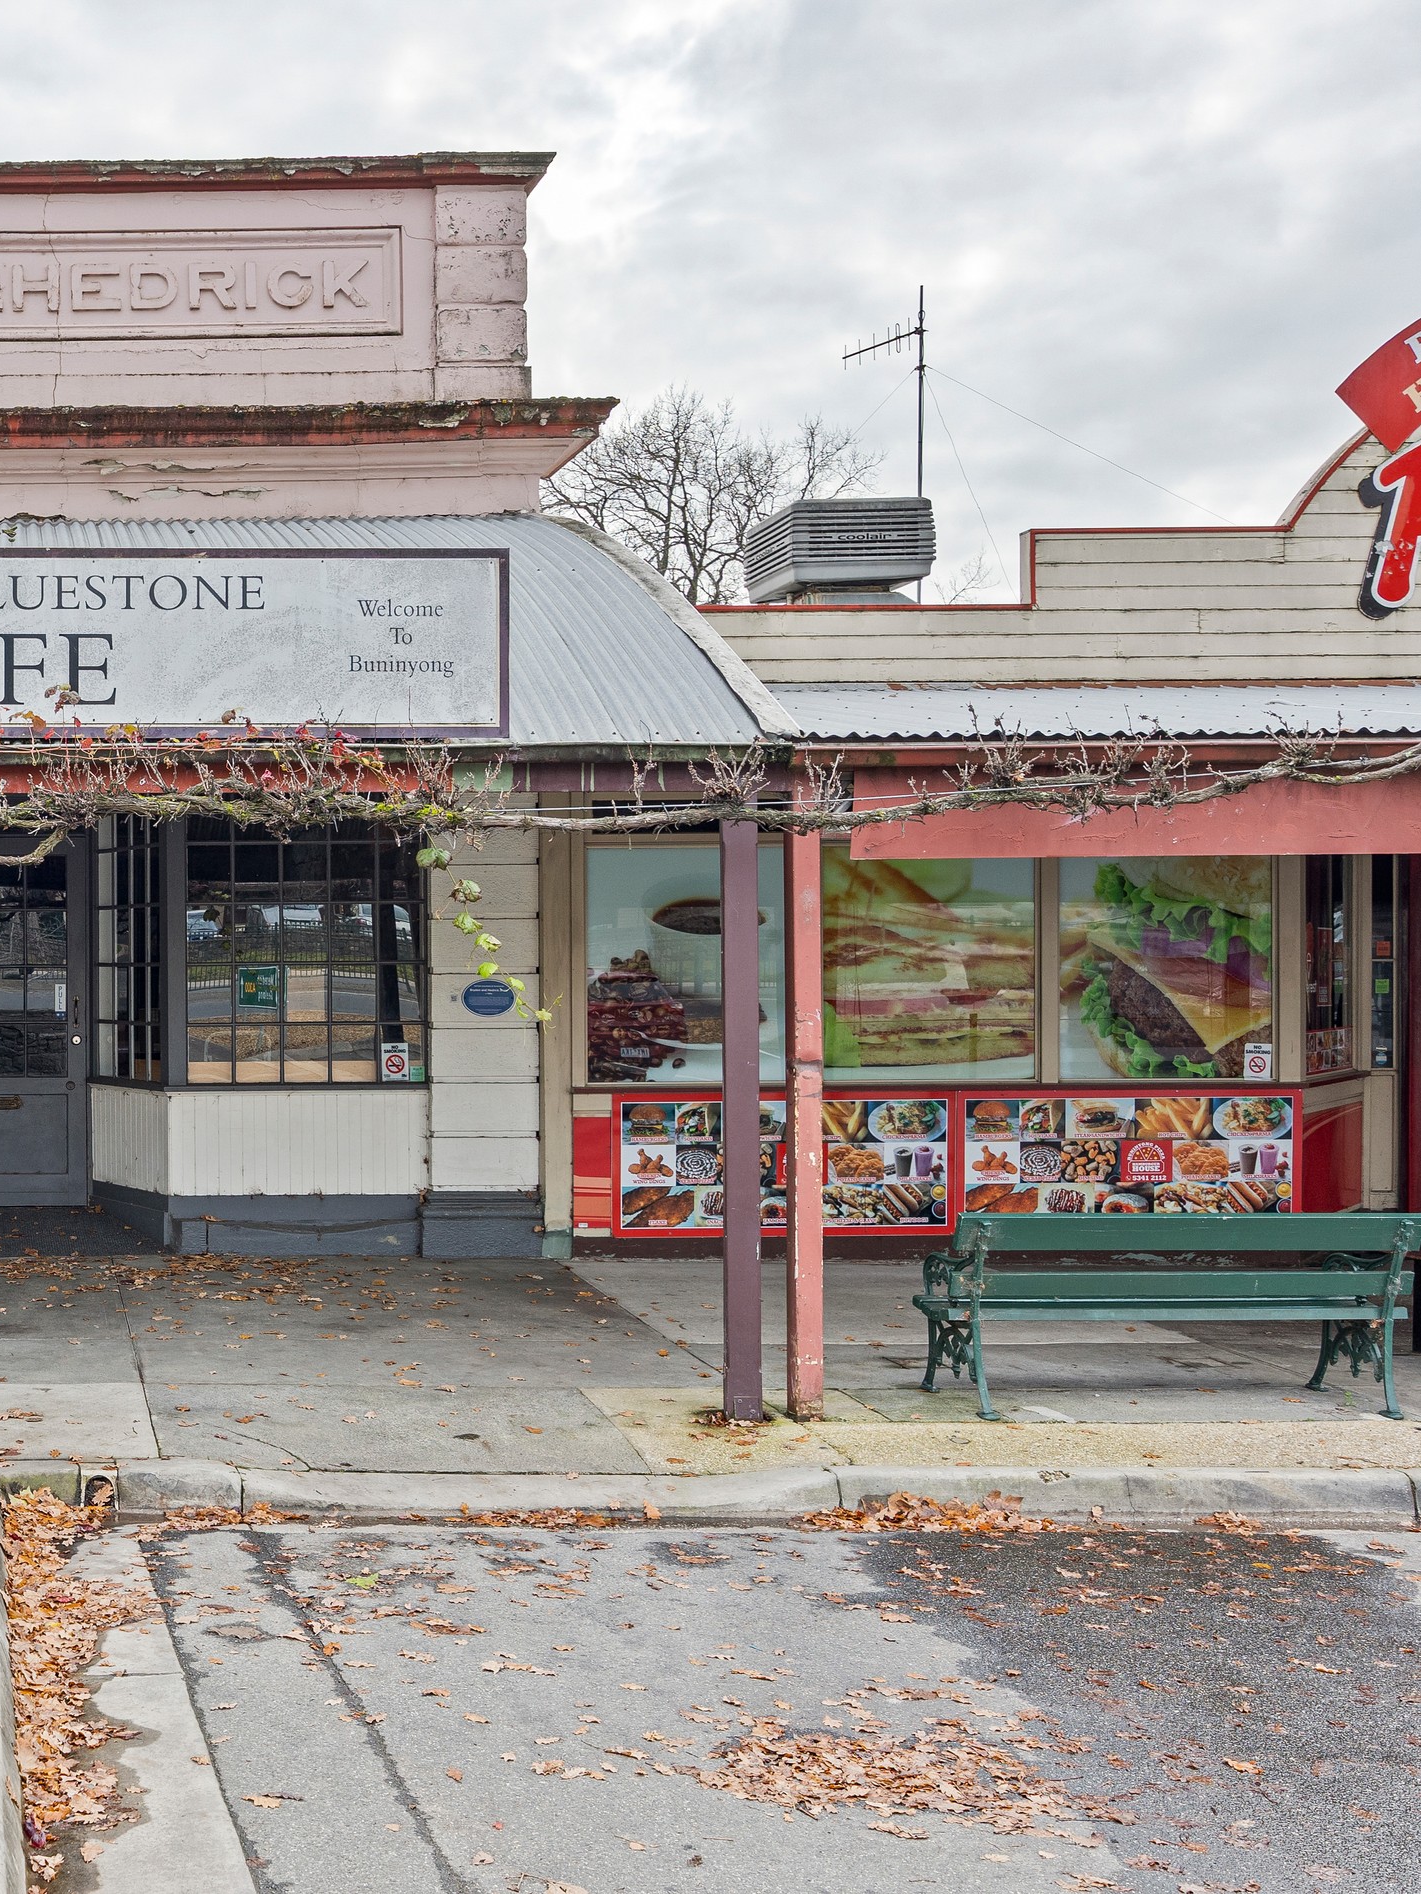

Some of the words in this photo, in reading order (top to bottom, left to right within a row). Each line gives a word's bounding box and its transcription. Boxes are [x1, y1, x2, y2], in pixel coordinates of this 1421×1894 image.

[357, 599, 443, 617] Welcome
[390, 627, 412, 645] To
[349, 655, 454, 678] Buninyong
[1154, 1145, 1166, 1160] PIZZA
